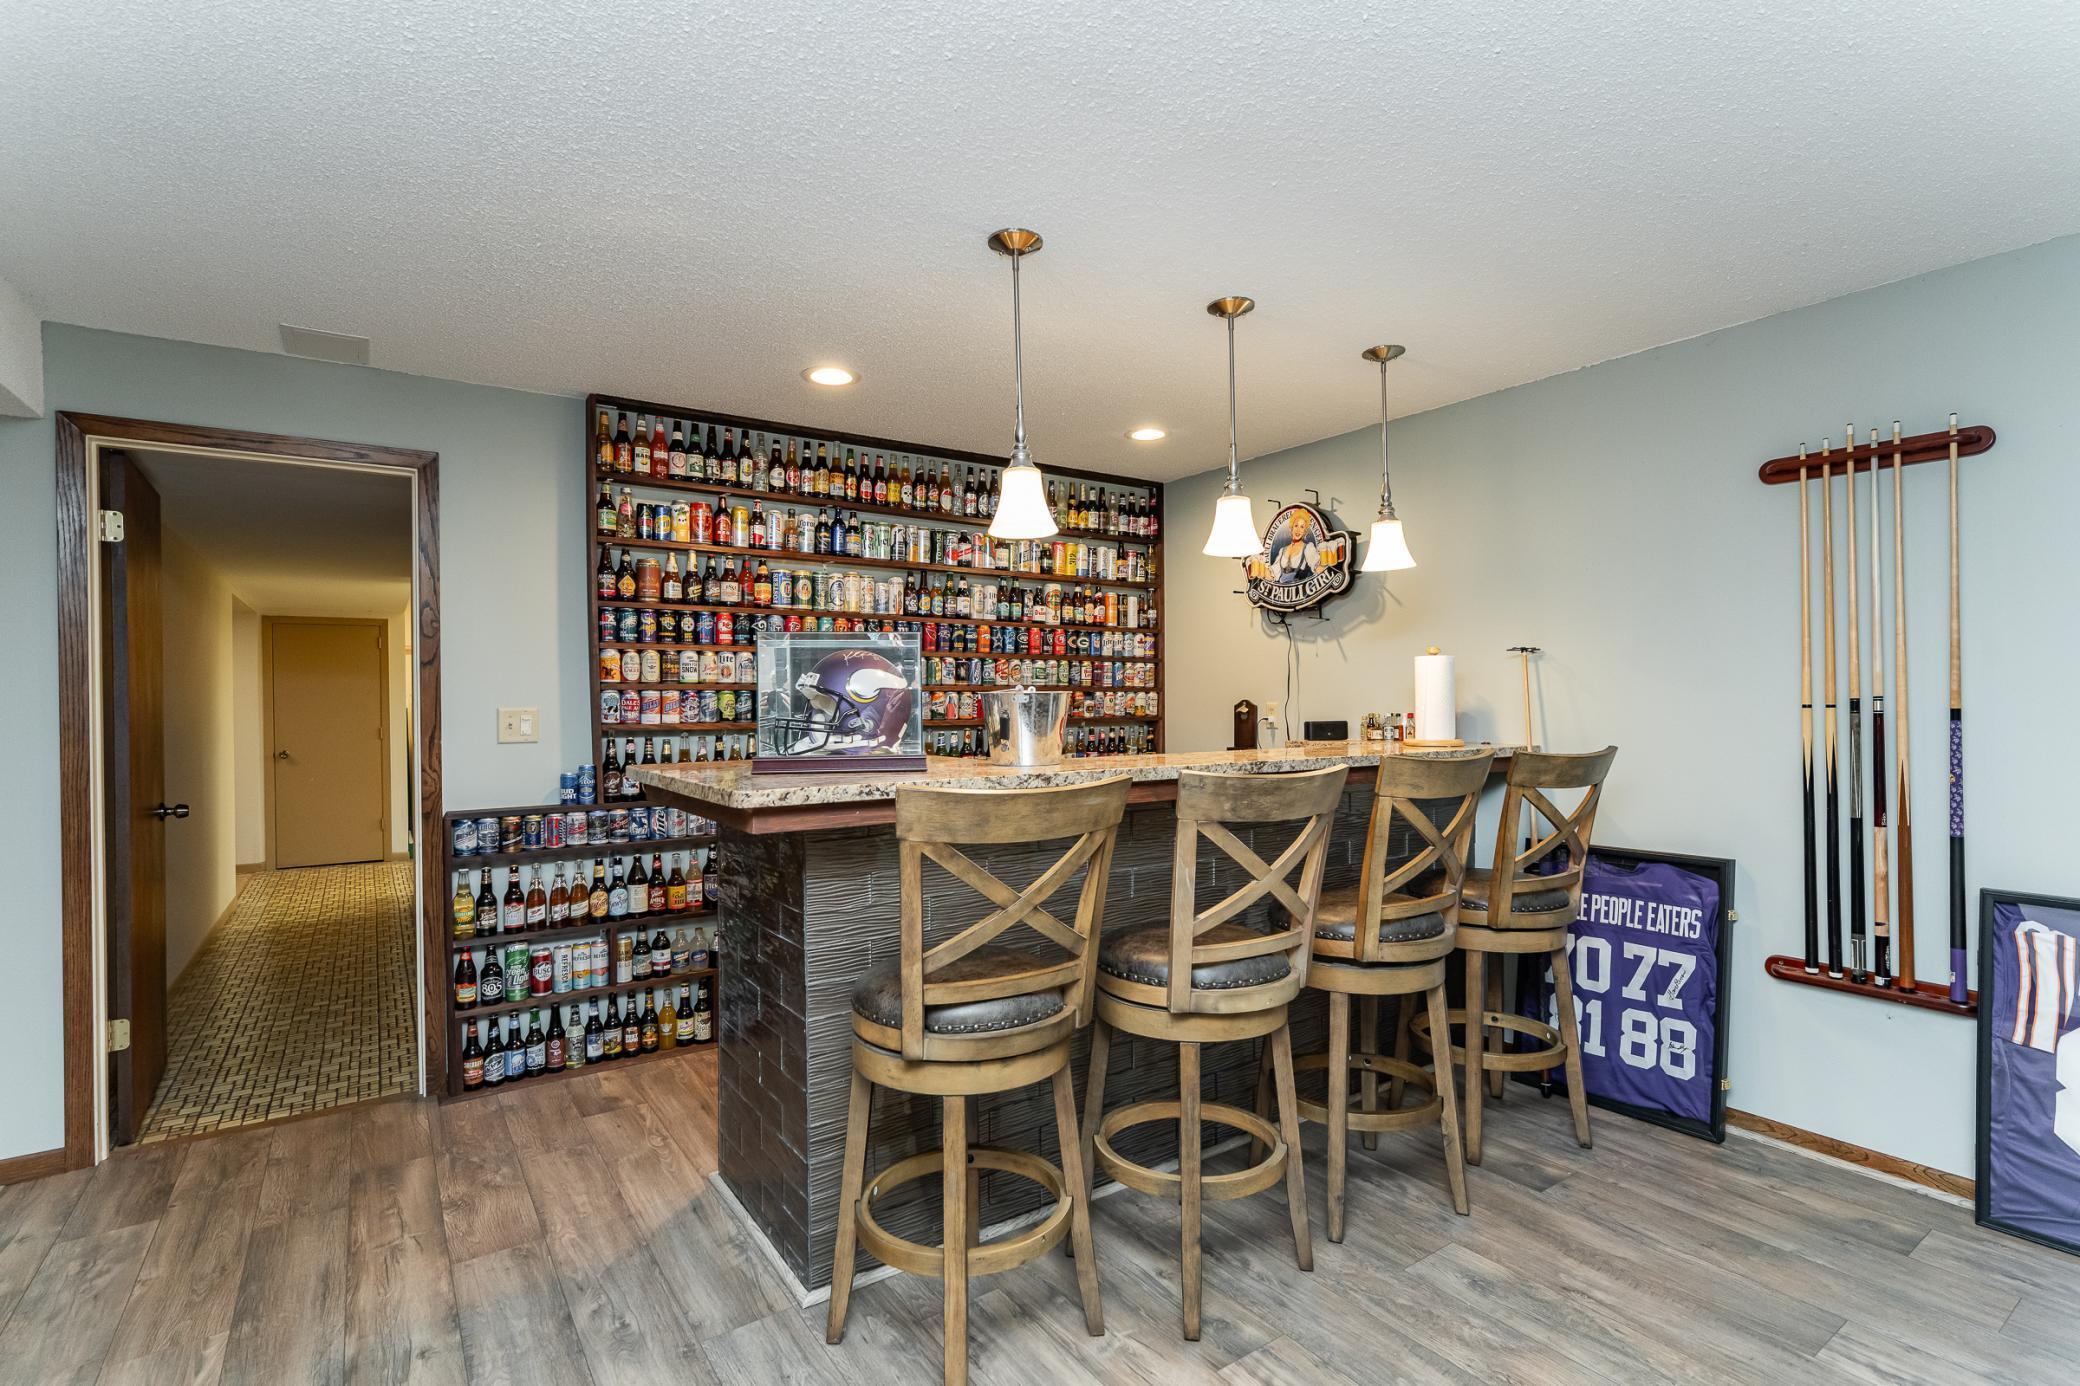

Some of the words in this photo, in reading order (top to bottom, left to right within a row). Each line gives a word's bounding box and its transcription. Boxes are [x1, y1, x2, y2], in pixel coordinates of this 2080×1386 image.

[1270, 584, 1305, 602] PAULI
[1305, 569, 1335, 596] GIRL
[719, 655, 734, 664] Lite
[1590, 894, 1643, 930] PEOPLE
[1647, 902, 1703, 939] EATERS
[533, 965, 552, 976] BUSC
[1621, 941, 1697, 1010] 77
[1619, 1007, 1697, 1081] 88
